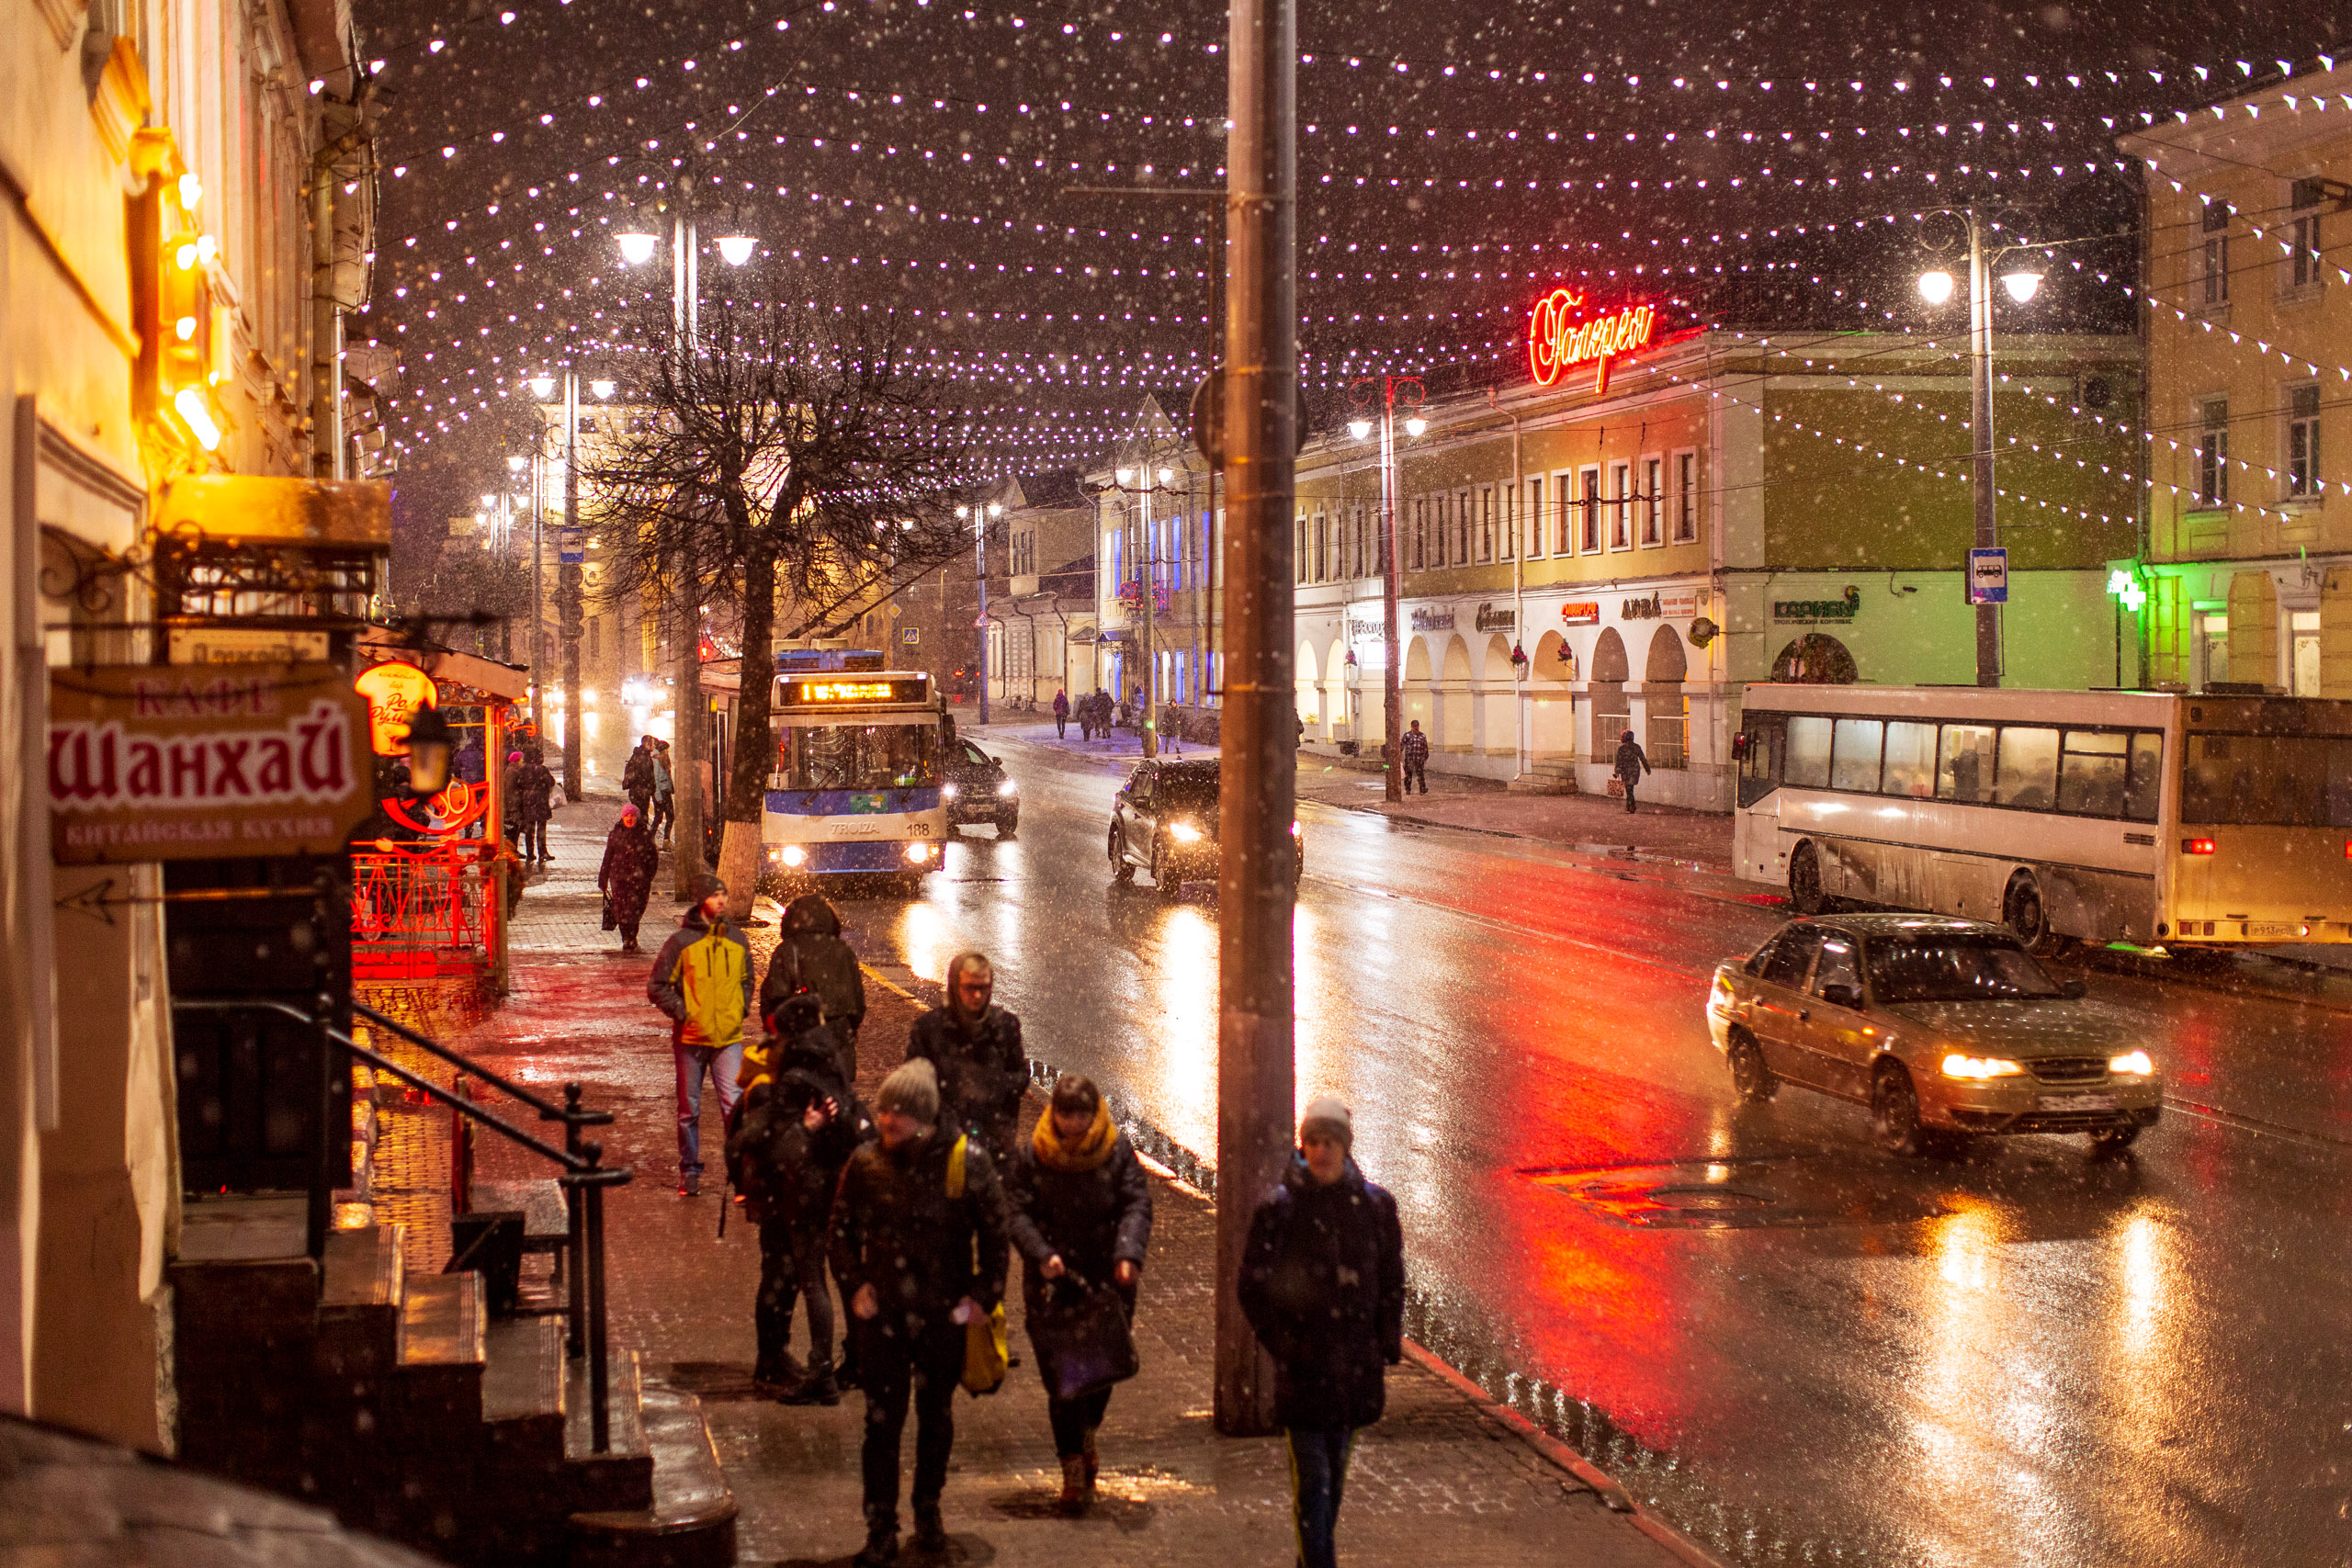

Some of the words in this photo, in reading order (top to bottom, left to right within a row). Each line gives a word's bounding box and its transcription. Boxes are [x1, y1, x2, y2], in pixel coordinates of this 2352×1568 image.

[134, 676, 282, 718] КАФЕ
[49, 702, 349, 807] Шанхай
[243, 817, 333, 840] КУХНЯ
[906, 823, 930, 837] 188
